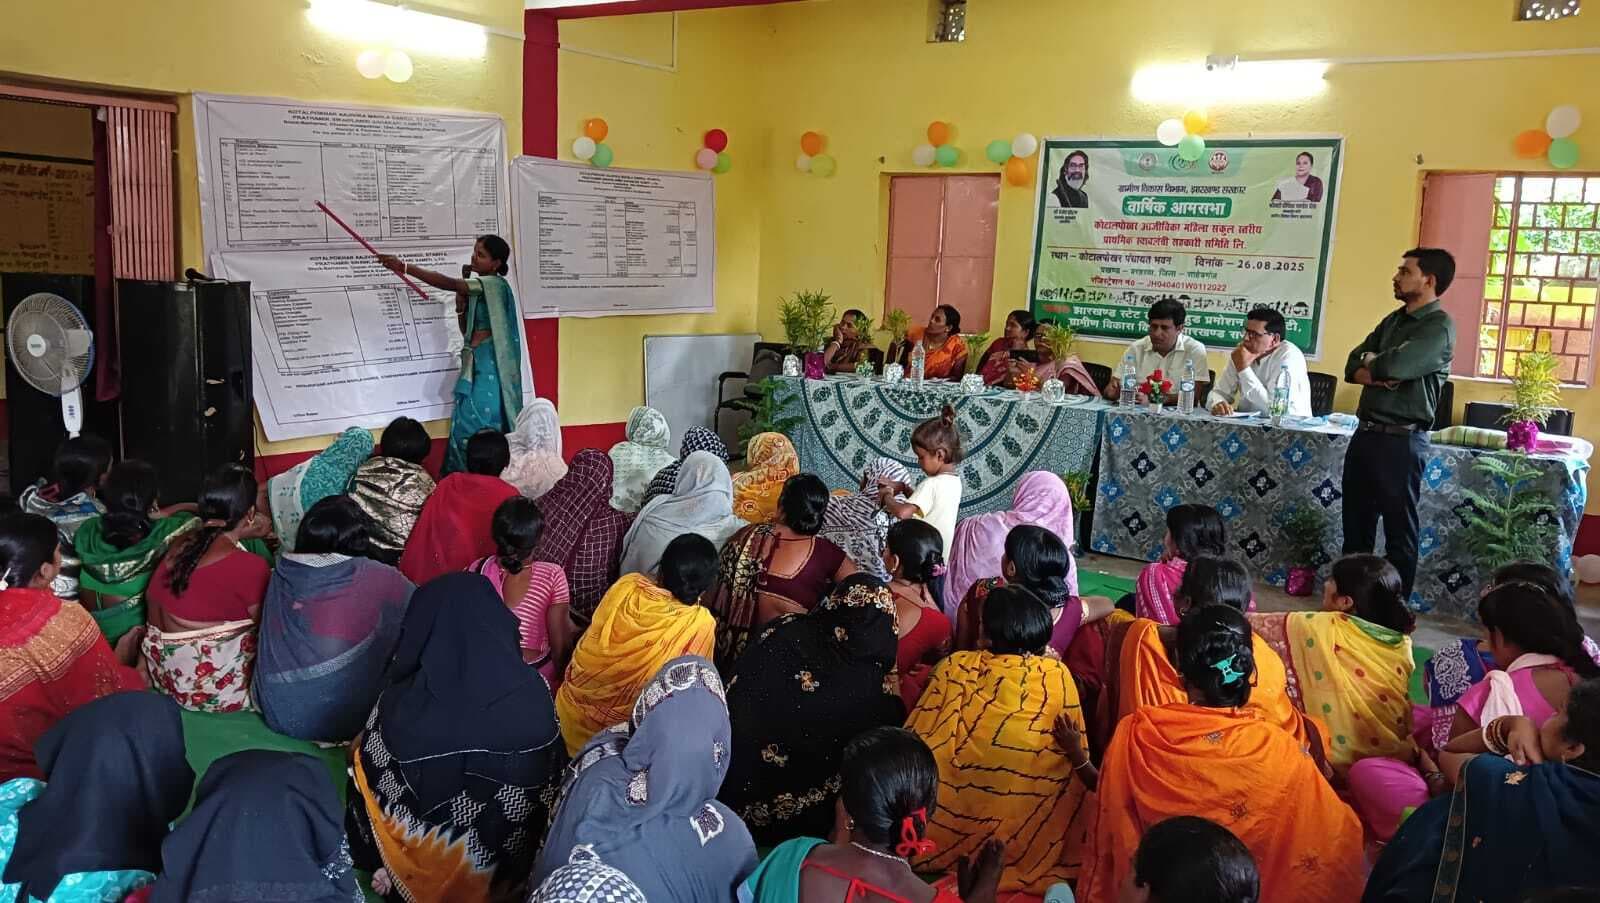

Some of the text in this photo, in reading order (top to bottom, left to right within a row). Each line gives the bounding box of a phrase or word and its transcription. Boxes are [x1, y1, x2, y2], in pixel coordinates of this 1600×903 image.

[1127, 197, 1226, 216] वार्षिक आमसभा
[1184, 222, 1209, 233] महिला
[1154, 256, 1172, 265] भवन
[1195, 255, 1224, 267] दिनांक
[1237, 259, 1305, 271] 26.08.2025
[1068, 315, 1100, 328] ग्रामीण
[1103, 318, 1135, 331] विकास
[1073, 306, 1116, 318] झारखण्ड
[1119, 307, 1141, 319] स्टेट
[1204, 314, 1244, 327] प्रमोशन
